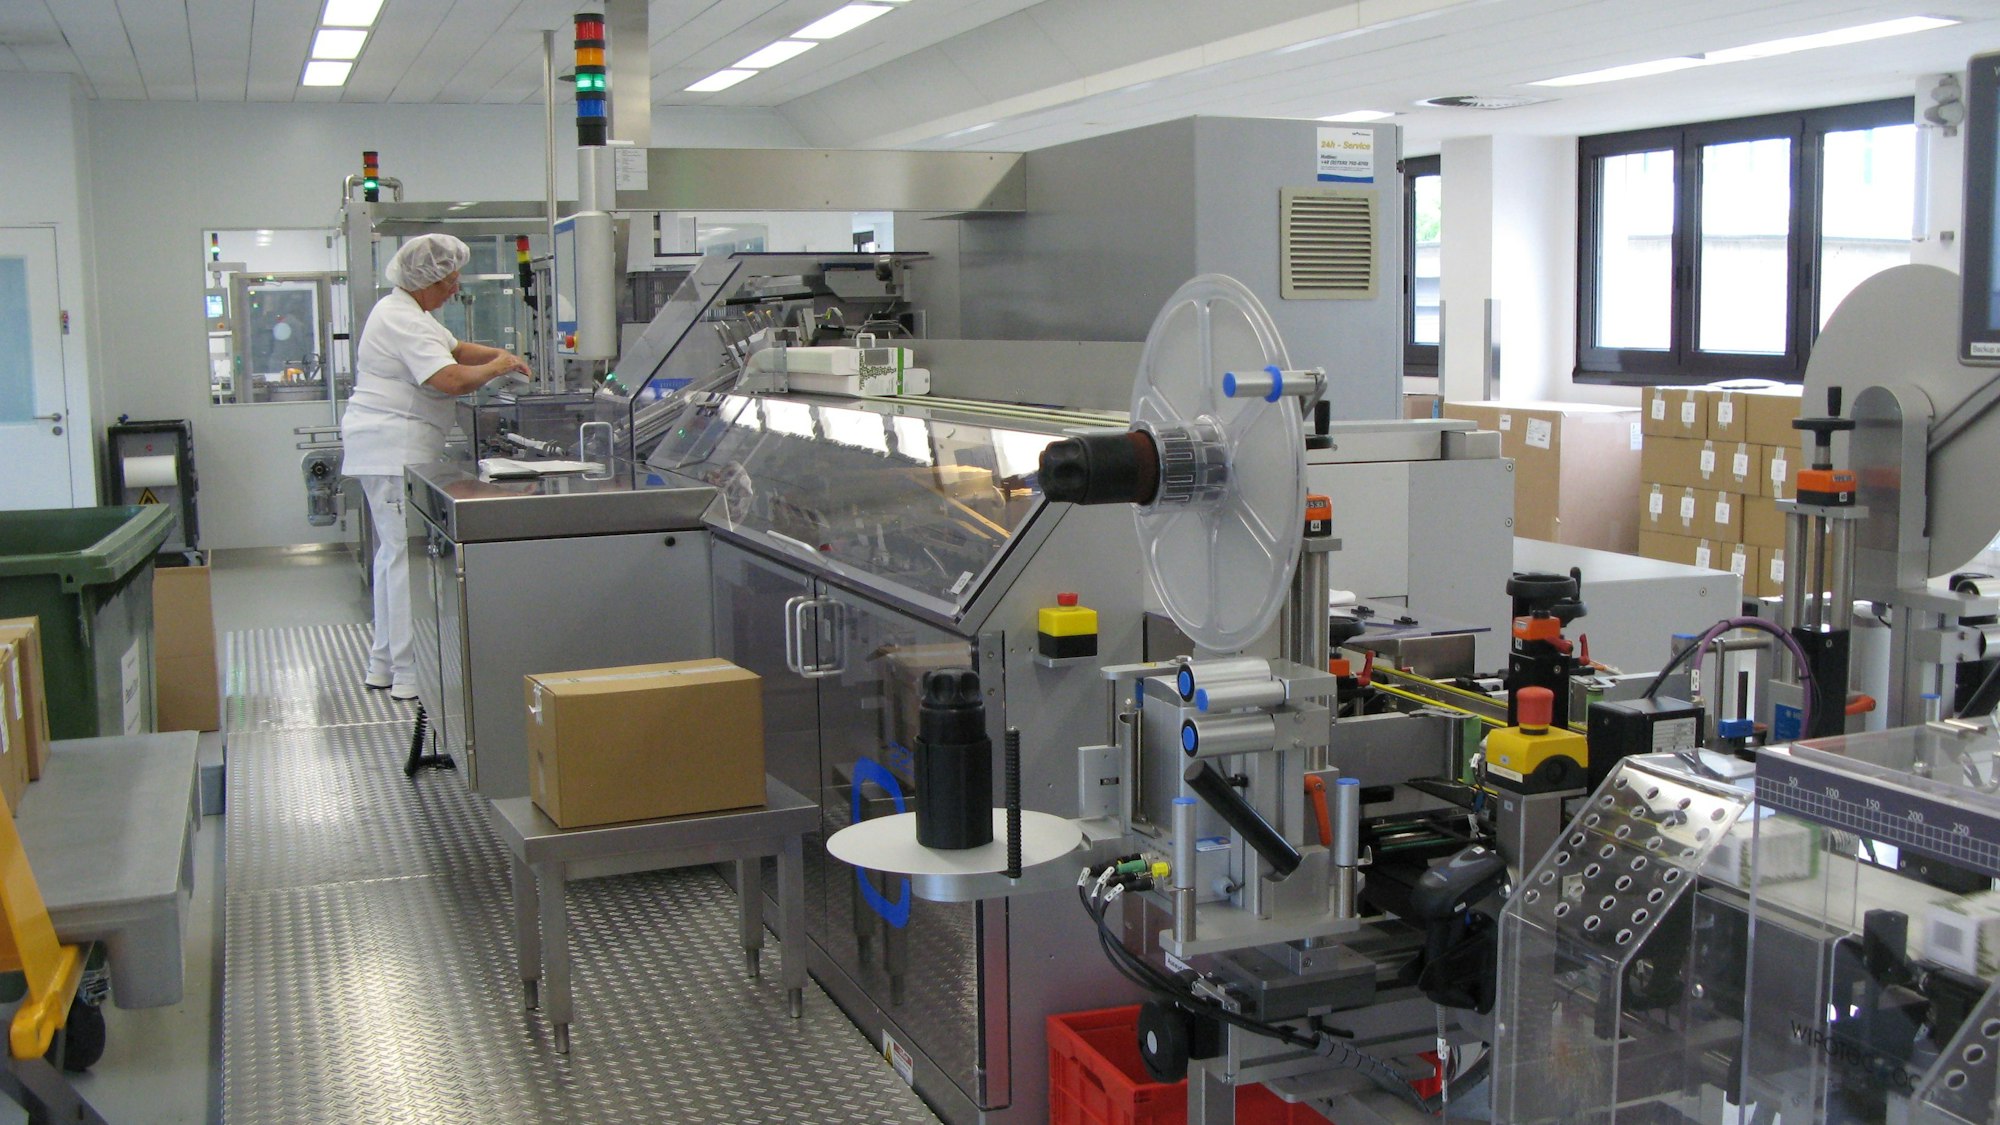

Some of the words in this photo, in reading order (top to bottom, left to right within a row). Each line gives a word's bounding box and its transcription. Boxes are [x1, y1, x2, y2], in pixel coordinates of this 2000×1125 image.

[1321, 140, 1336, 149] 24h
[1343, 140, 1371, 150] Service
[1312, 522, 1320, 530] 44
[1788, 777, 1798, 787] 50
[1825, 786, 1840, 800] 100
[1866, 797, 1881, 811] 150
[1907, 809, 1924, 823] 200
[1952, 822, 1970, 837] 250
